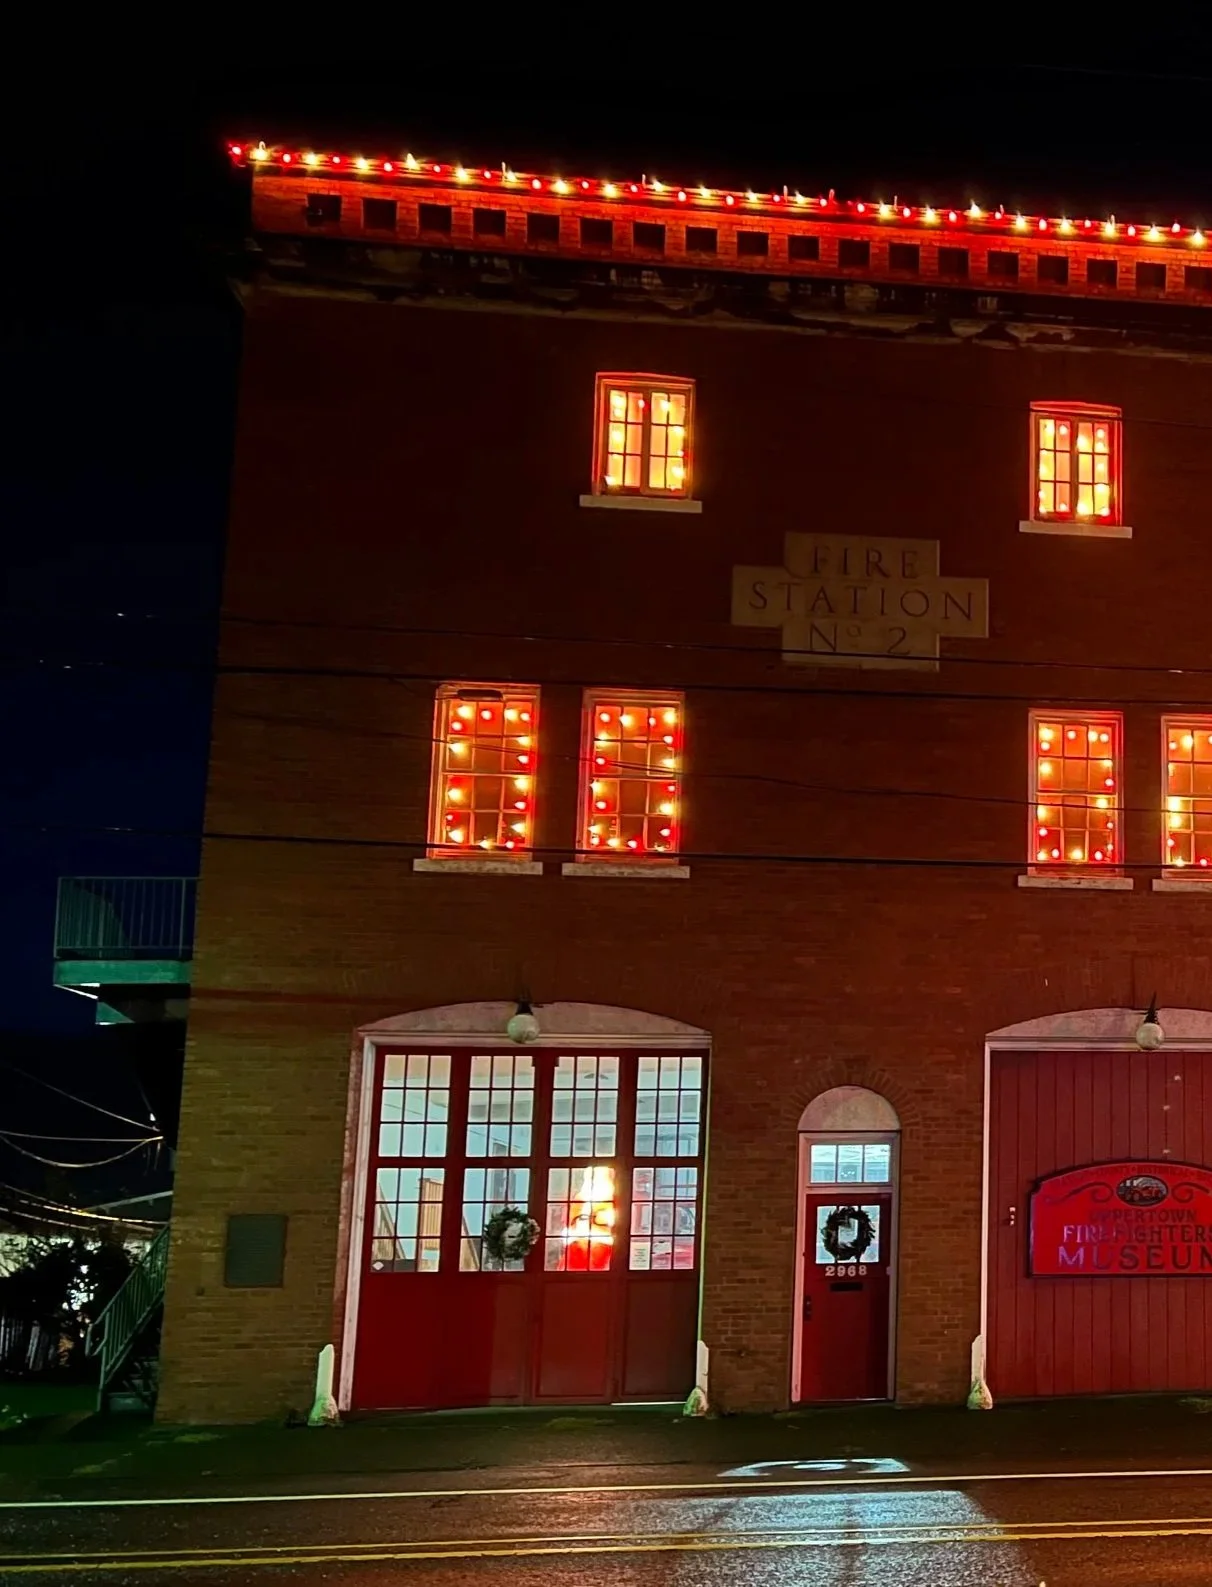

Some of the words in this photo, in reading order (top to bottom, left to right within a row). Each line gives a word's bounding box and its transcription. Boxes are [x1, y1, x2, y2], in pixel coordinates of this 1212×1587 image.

[812, 545, 919, 579] FIRE
[748, 581, 973, 621] STATION
[886, 626, 911, 656] 2
[825, 1265, 868, 1277] 2968
